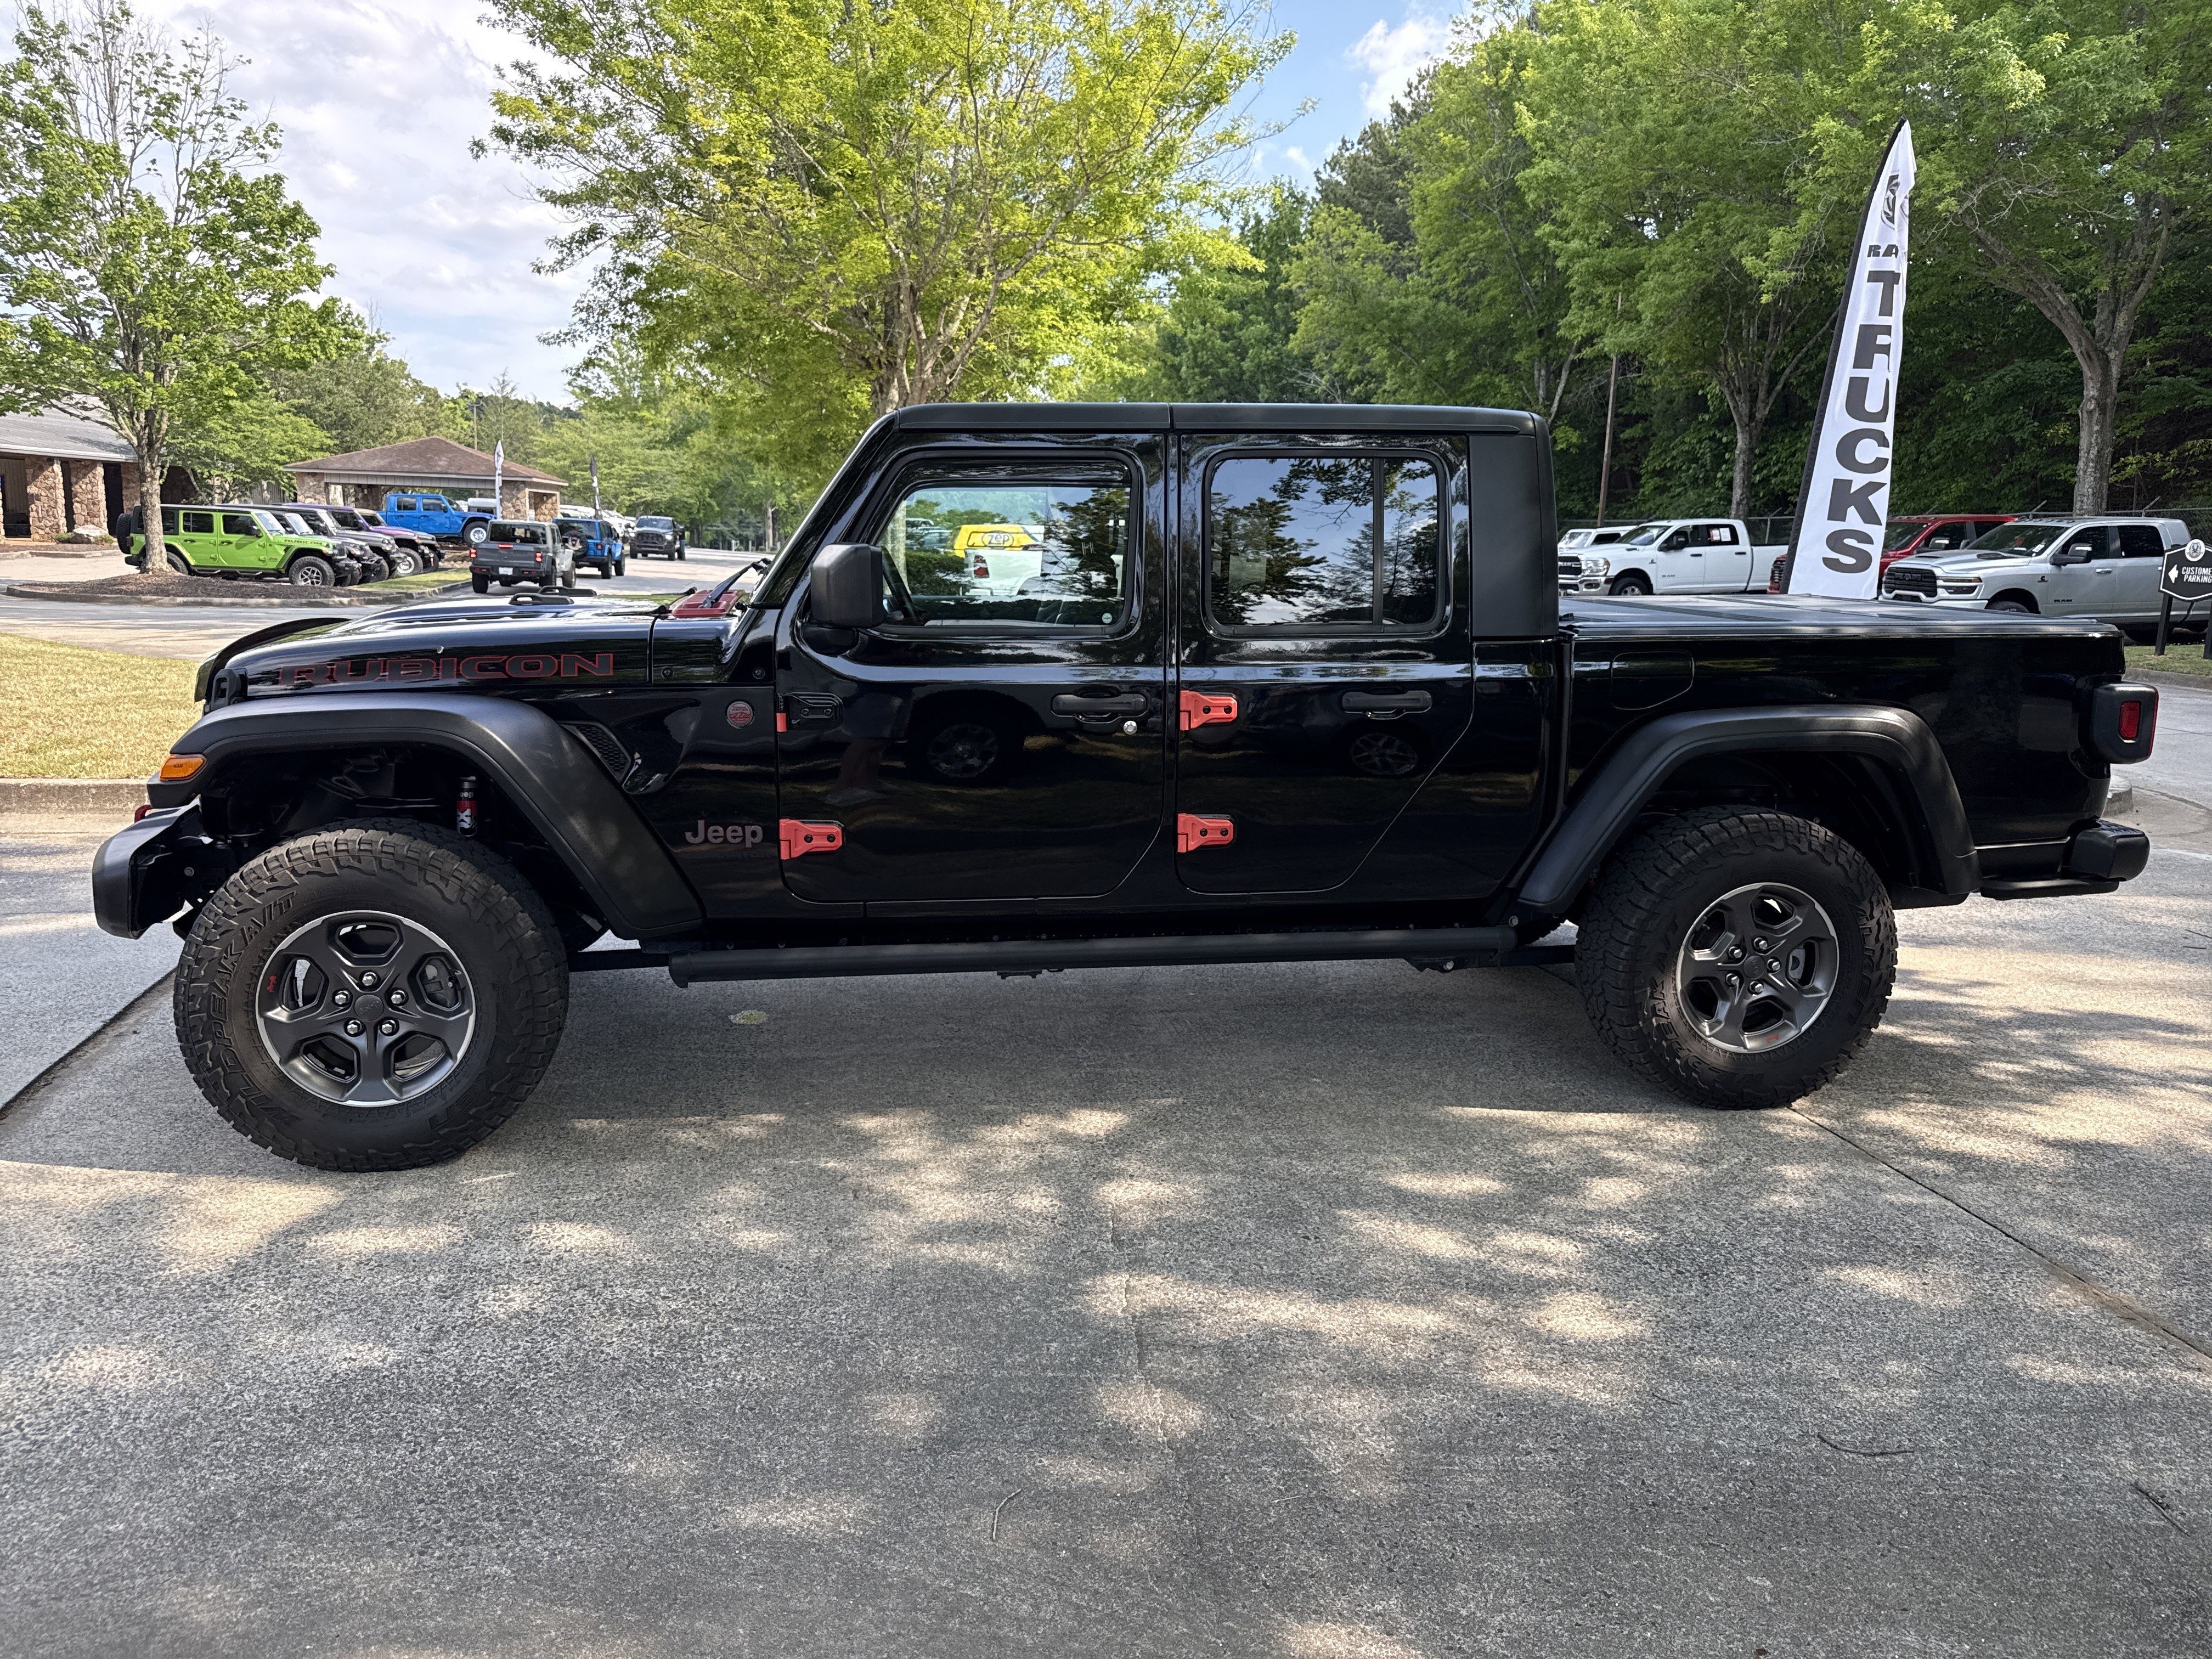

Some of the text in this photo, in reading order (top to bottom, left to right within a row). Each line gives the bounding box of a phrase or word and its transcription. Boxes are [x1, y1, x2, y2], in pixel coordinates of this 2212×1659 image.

[1867, 244, 1899, 259] RA
[1822, 270, 1901, 574] TRUCKS
[2182, 566, 2212, 576] CUSTOME
[2183, 574, 2212, 583] PARKING
[279, 653, 613, 686] RUBICON
[685, 820, 763, 848] Jeep
